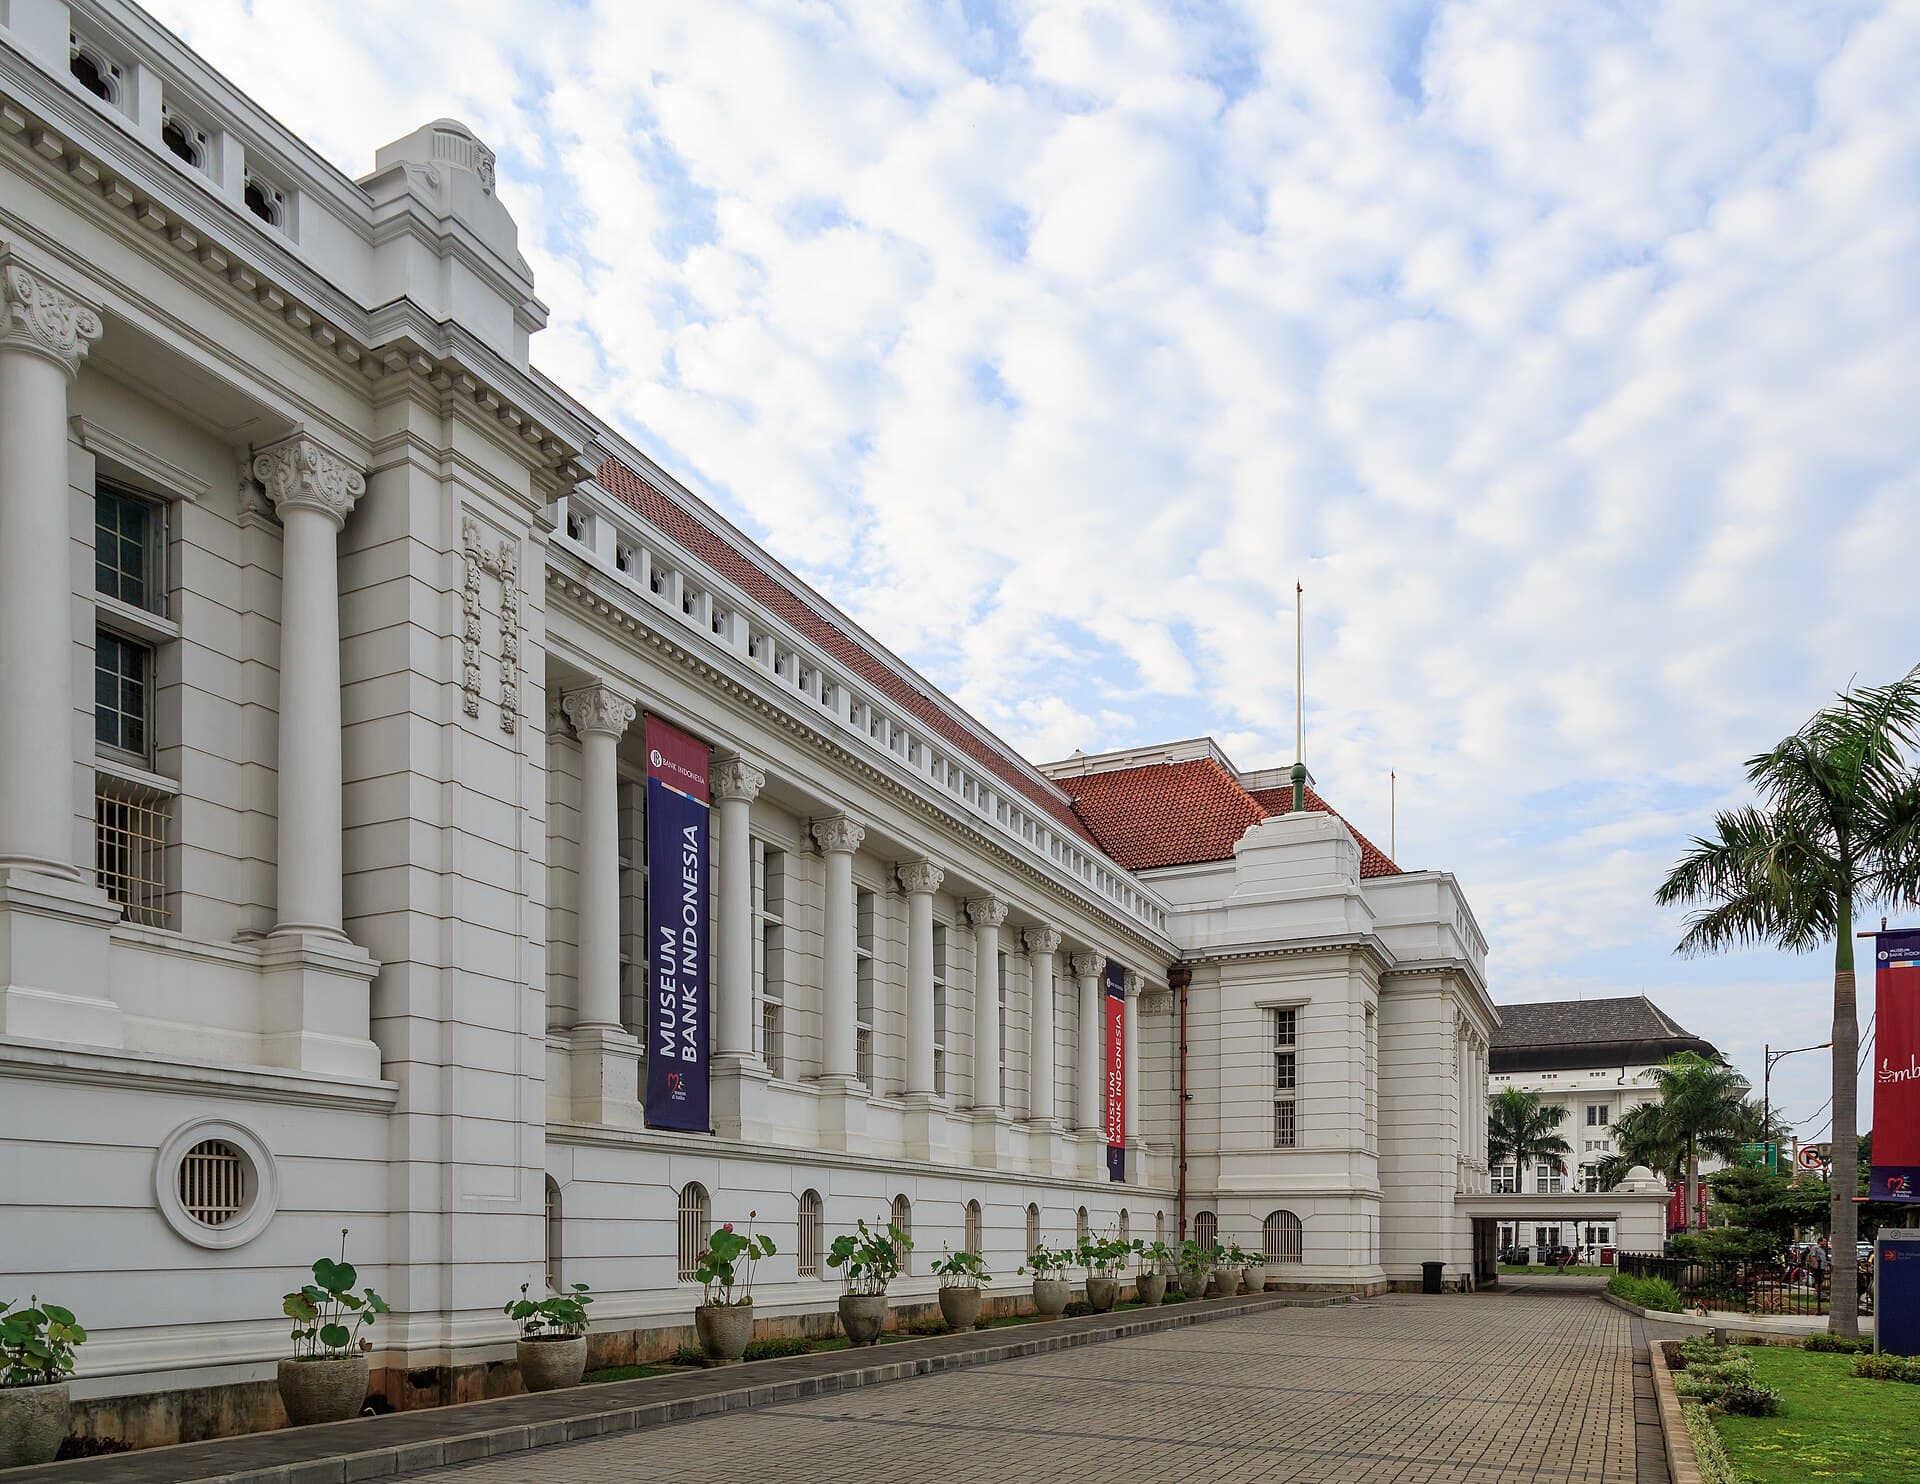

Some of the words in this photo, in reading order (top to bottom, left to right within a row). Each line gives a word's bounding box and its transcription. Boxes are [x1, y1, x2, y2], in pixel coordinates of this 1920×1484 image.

[663, 758, 677, 772] BANK
[677, 766, 705, 785] INDONESIA
[683, 825, 698, 976] INDONESIA
[660, 926, 676, 1058] MUSEUM
[682, 984, 697, 1063] BANK
